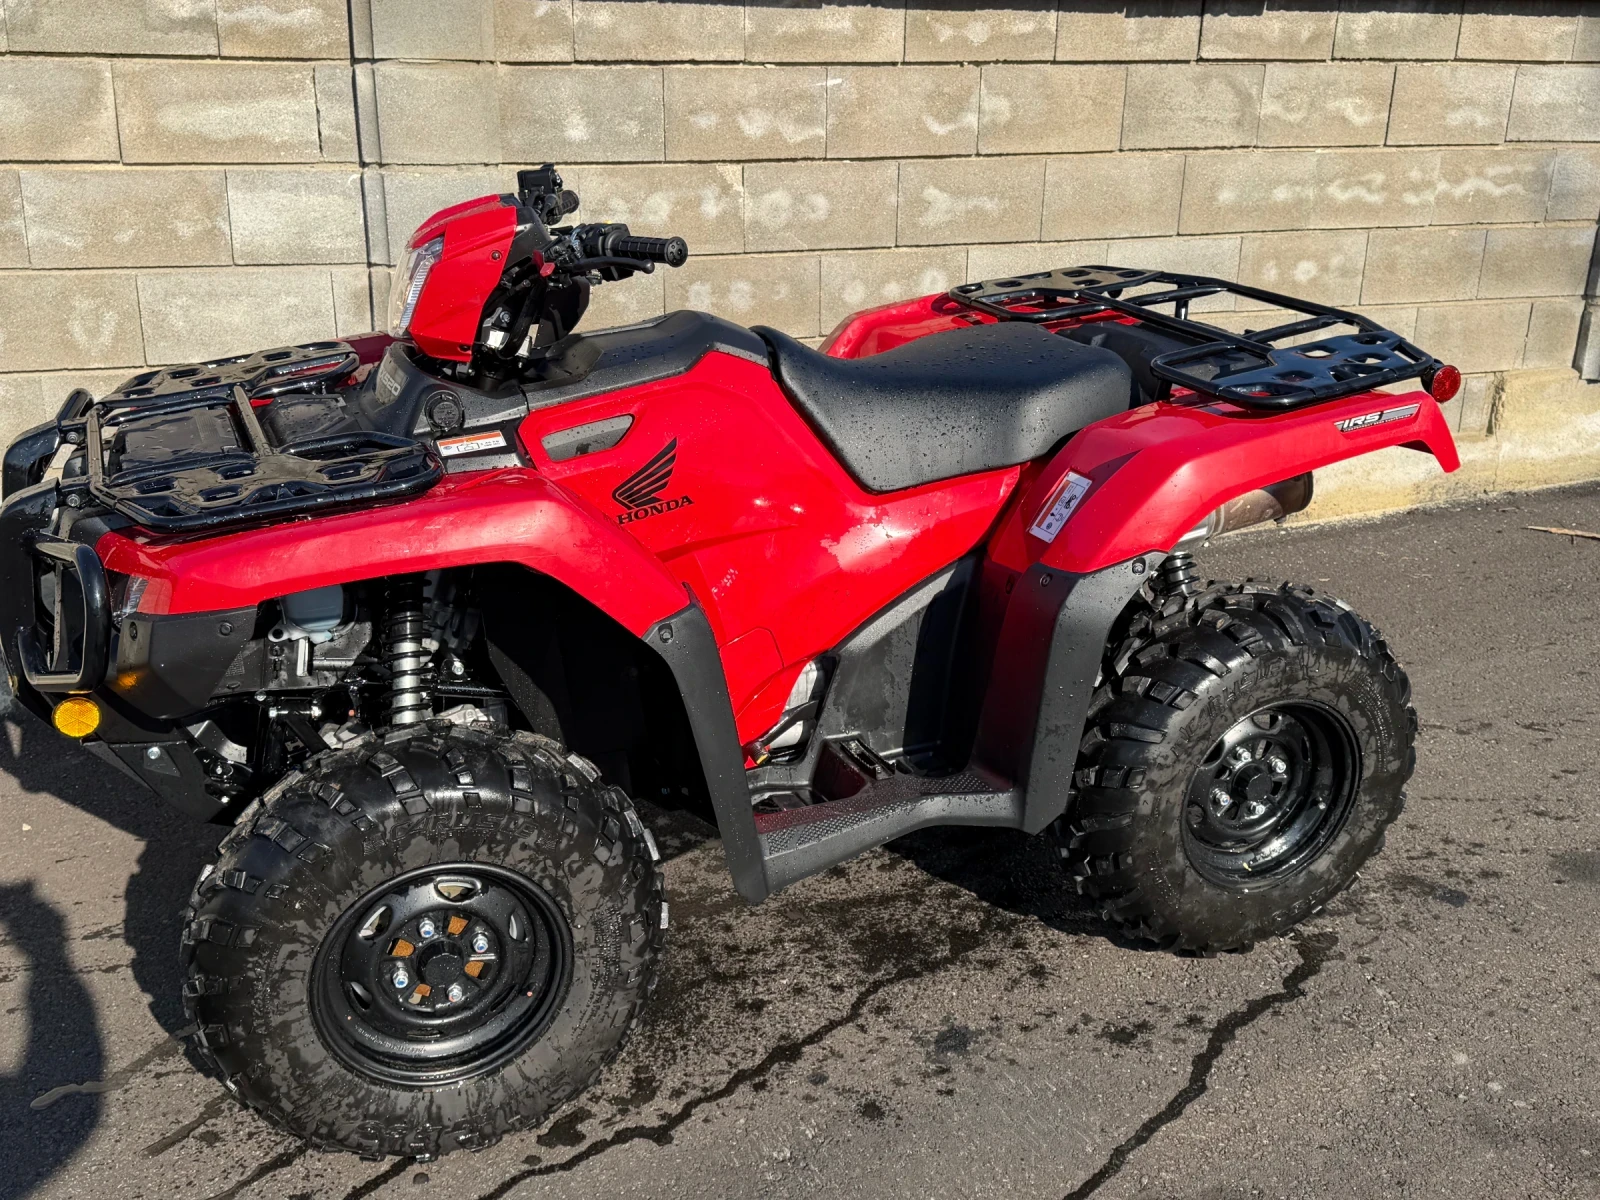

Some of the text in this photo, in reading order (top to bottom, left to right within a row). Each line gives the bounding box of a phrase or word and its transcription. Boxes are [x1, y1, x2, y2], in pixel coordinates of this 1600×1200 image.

[1343, 412, 1382, 428] IRS
[617, 495, 694, 525] HONDA
[391, 811, 538, 843] CARLISLE
